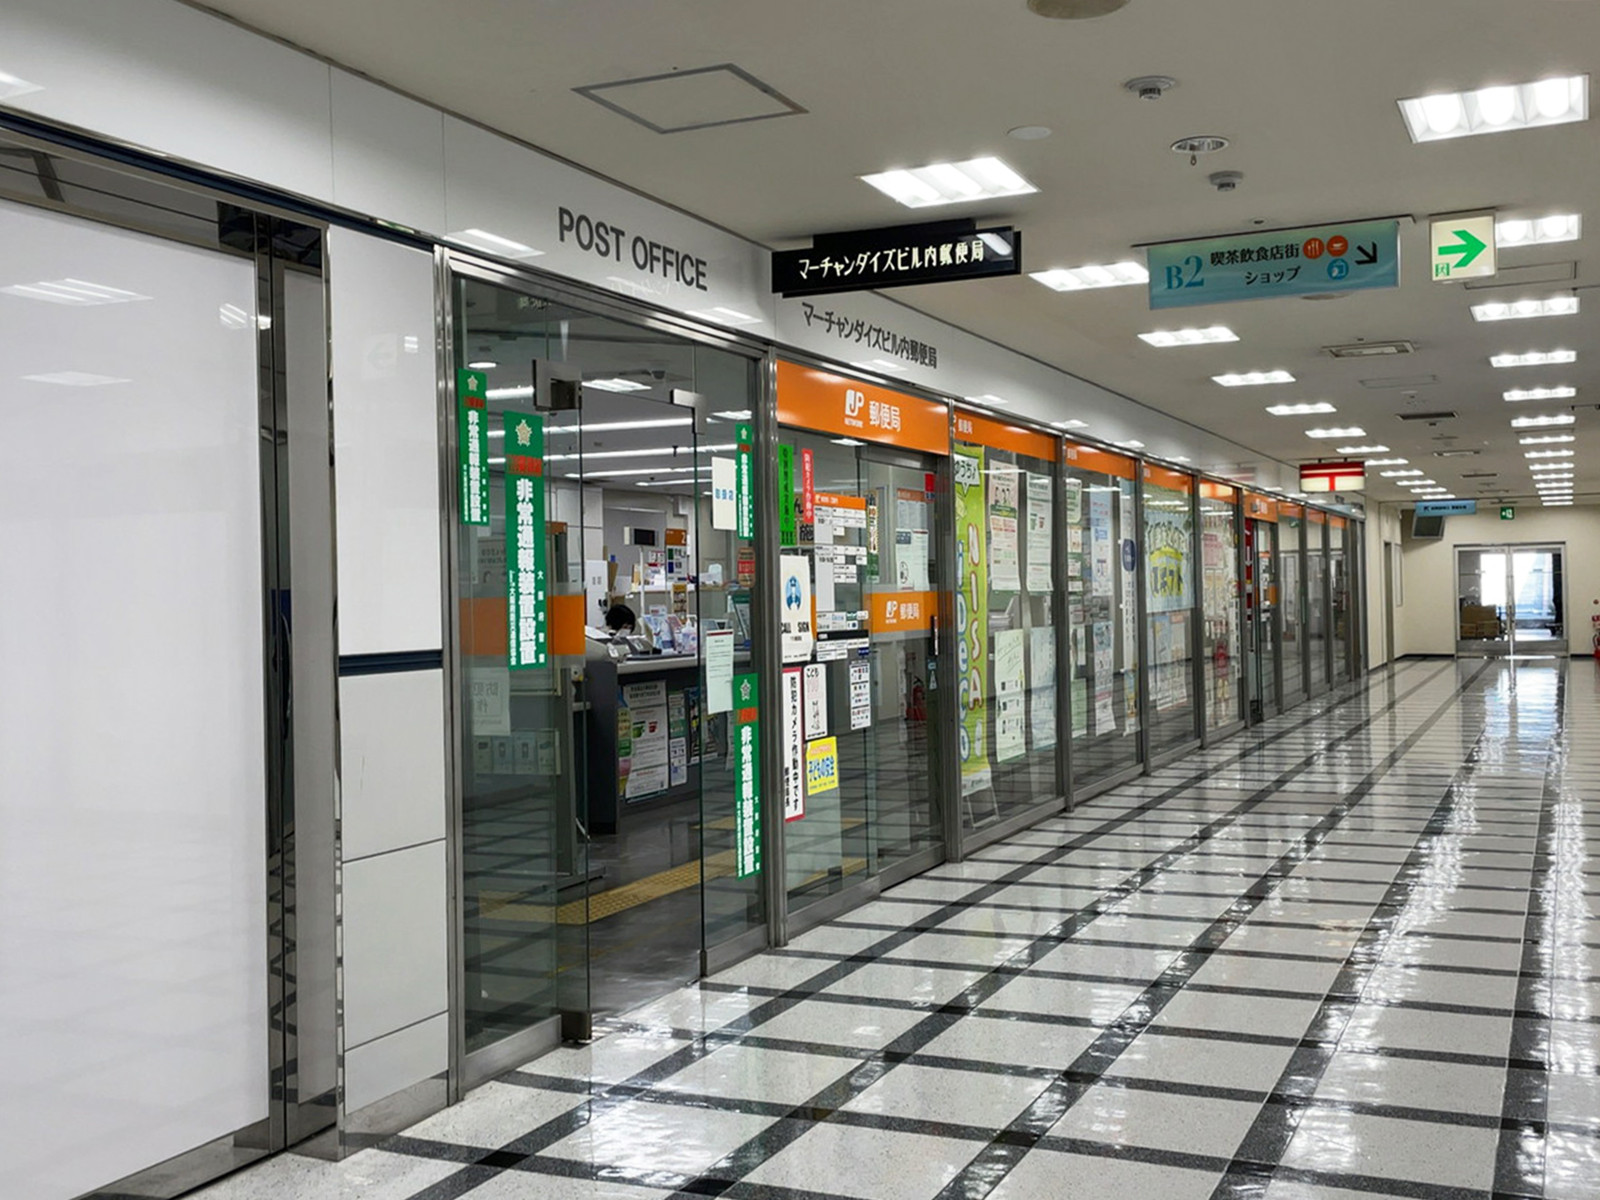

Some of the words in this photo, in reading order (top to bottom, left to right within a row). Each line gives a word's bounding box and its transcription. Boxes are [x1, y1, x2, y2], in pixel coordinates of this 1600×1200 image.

[558, 206, 625, 263] POST
[631, 235, 708, 292] OFFICE
[798, 239, 985, 279] マーチャンダイズビル内郵便局
[1210, 243, 1300, 267] 喫茶飲食店街
[1165, 254, 1205, 290] B2
[1244, 267, 1301, 286] ショップ
[801, 301, 938, 370] マーチャンダイズビル内郵便局
[868, 400, 901, 433] 郵便局
[968, 523, 983, 711] NISA
